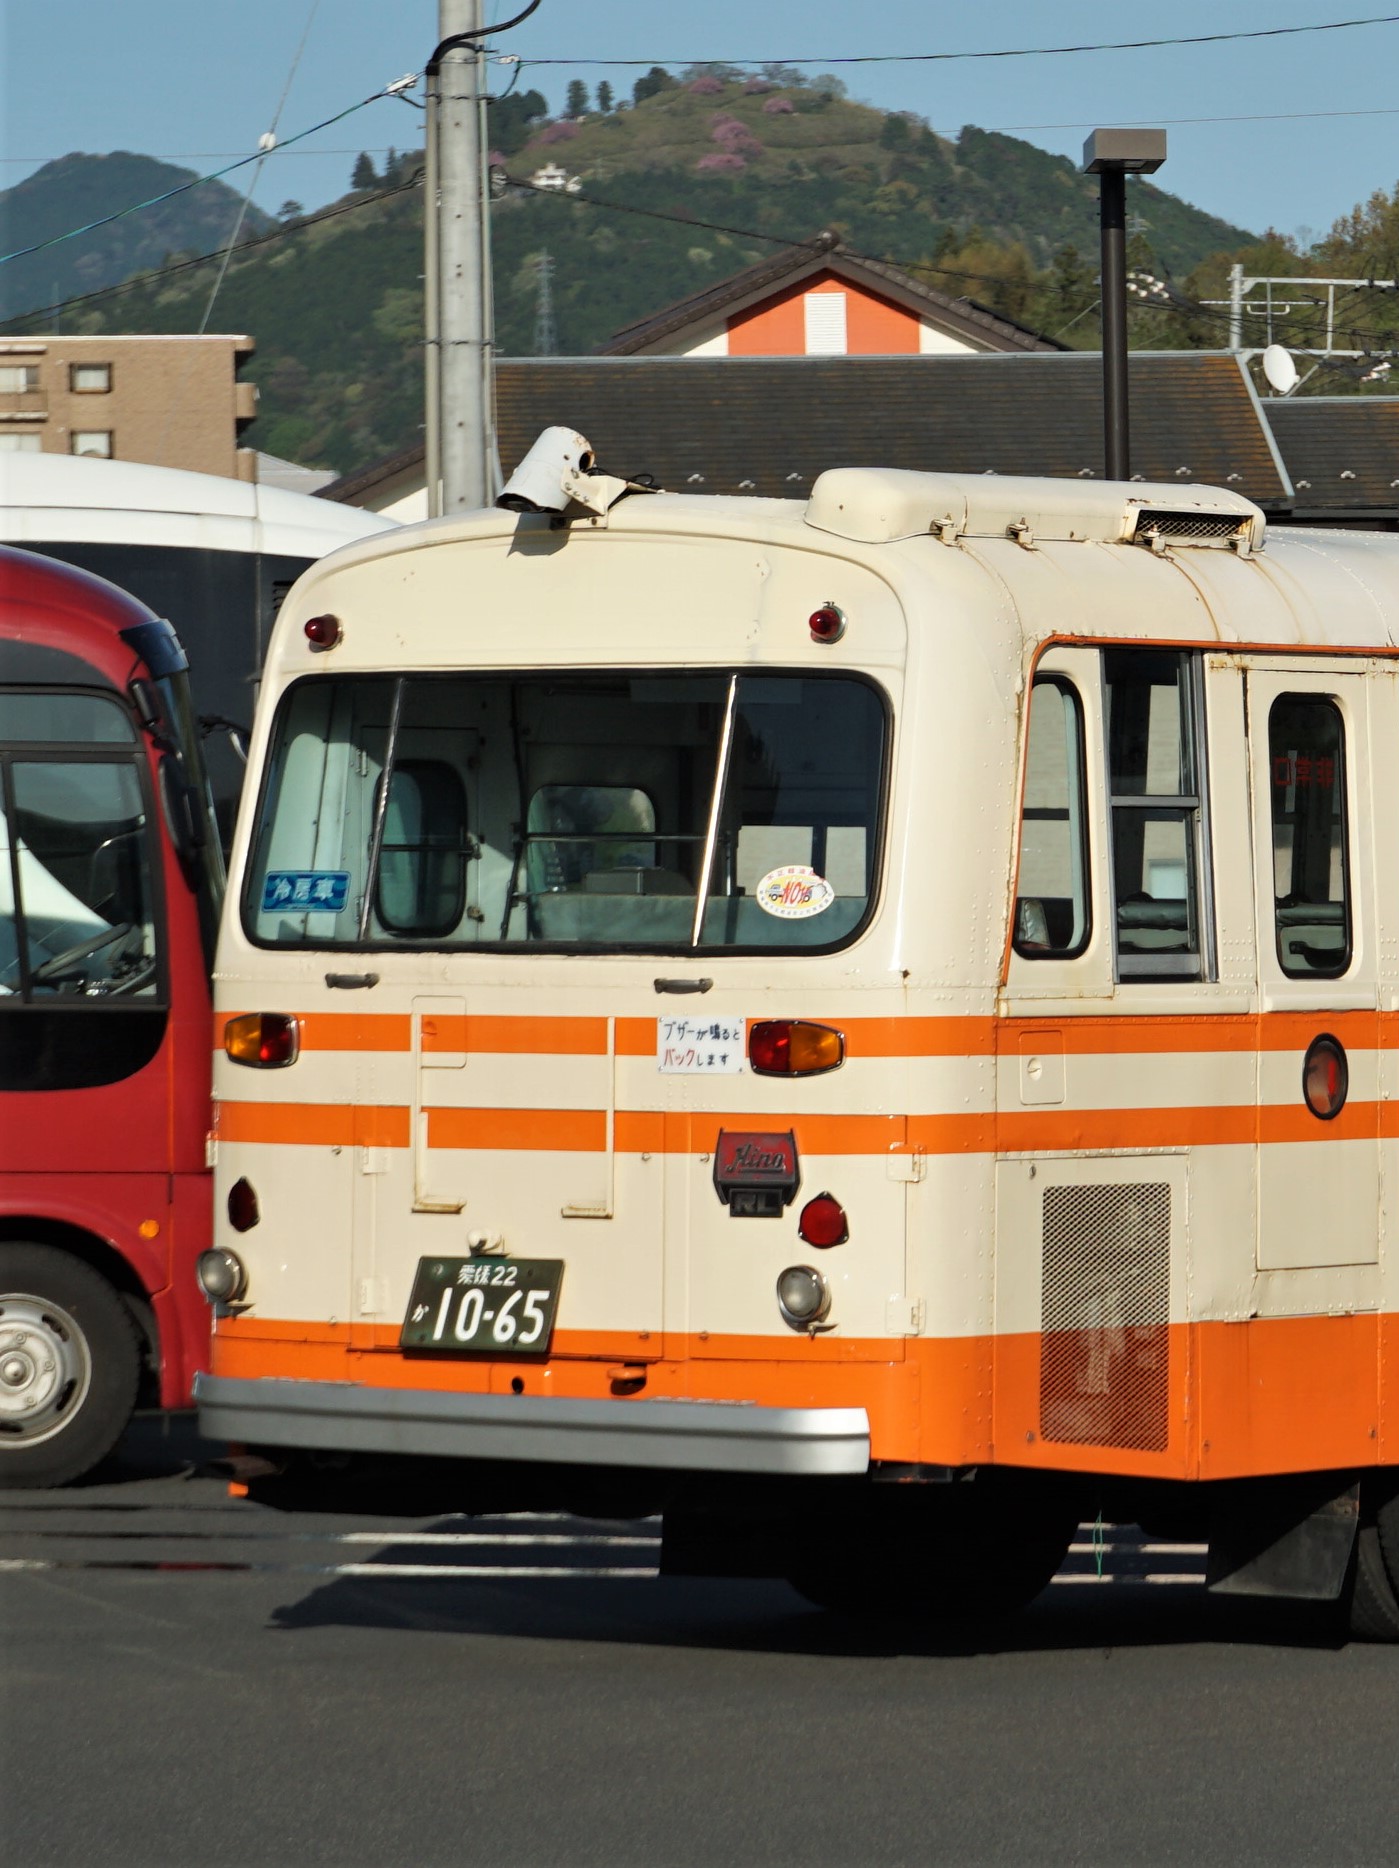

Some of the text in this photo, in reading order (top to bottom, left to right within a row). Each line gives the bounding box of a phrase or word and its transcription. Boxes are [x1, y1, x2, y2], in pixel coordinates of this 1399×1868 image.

[273, 877, 336, 901] 冷房車
[664, 1021, 740, 1041] ブザーが鳴ると
[664, 1048, 729, 1067] バックします
[725, 1143, 787, 1173] Hino
[432, 1287, 551, 1344] 10-65
